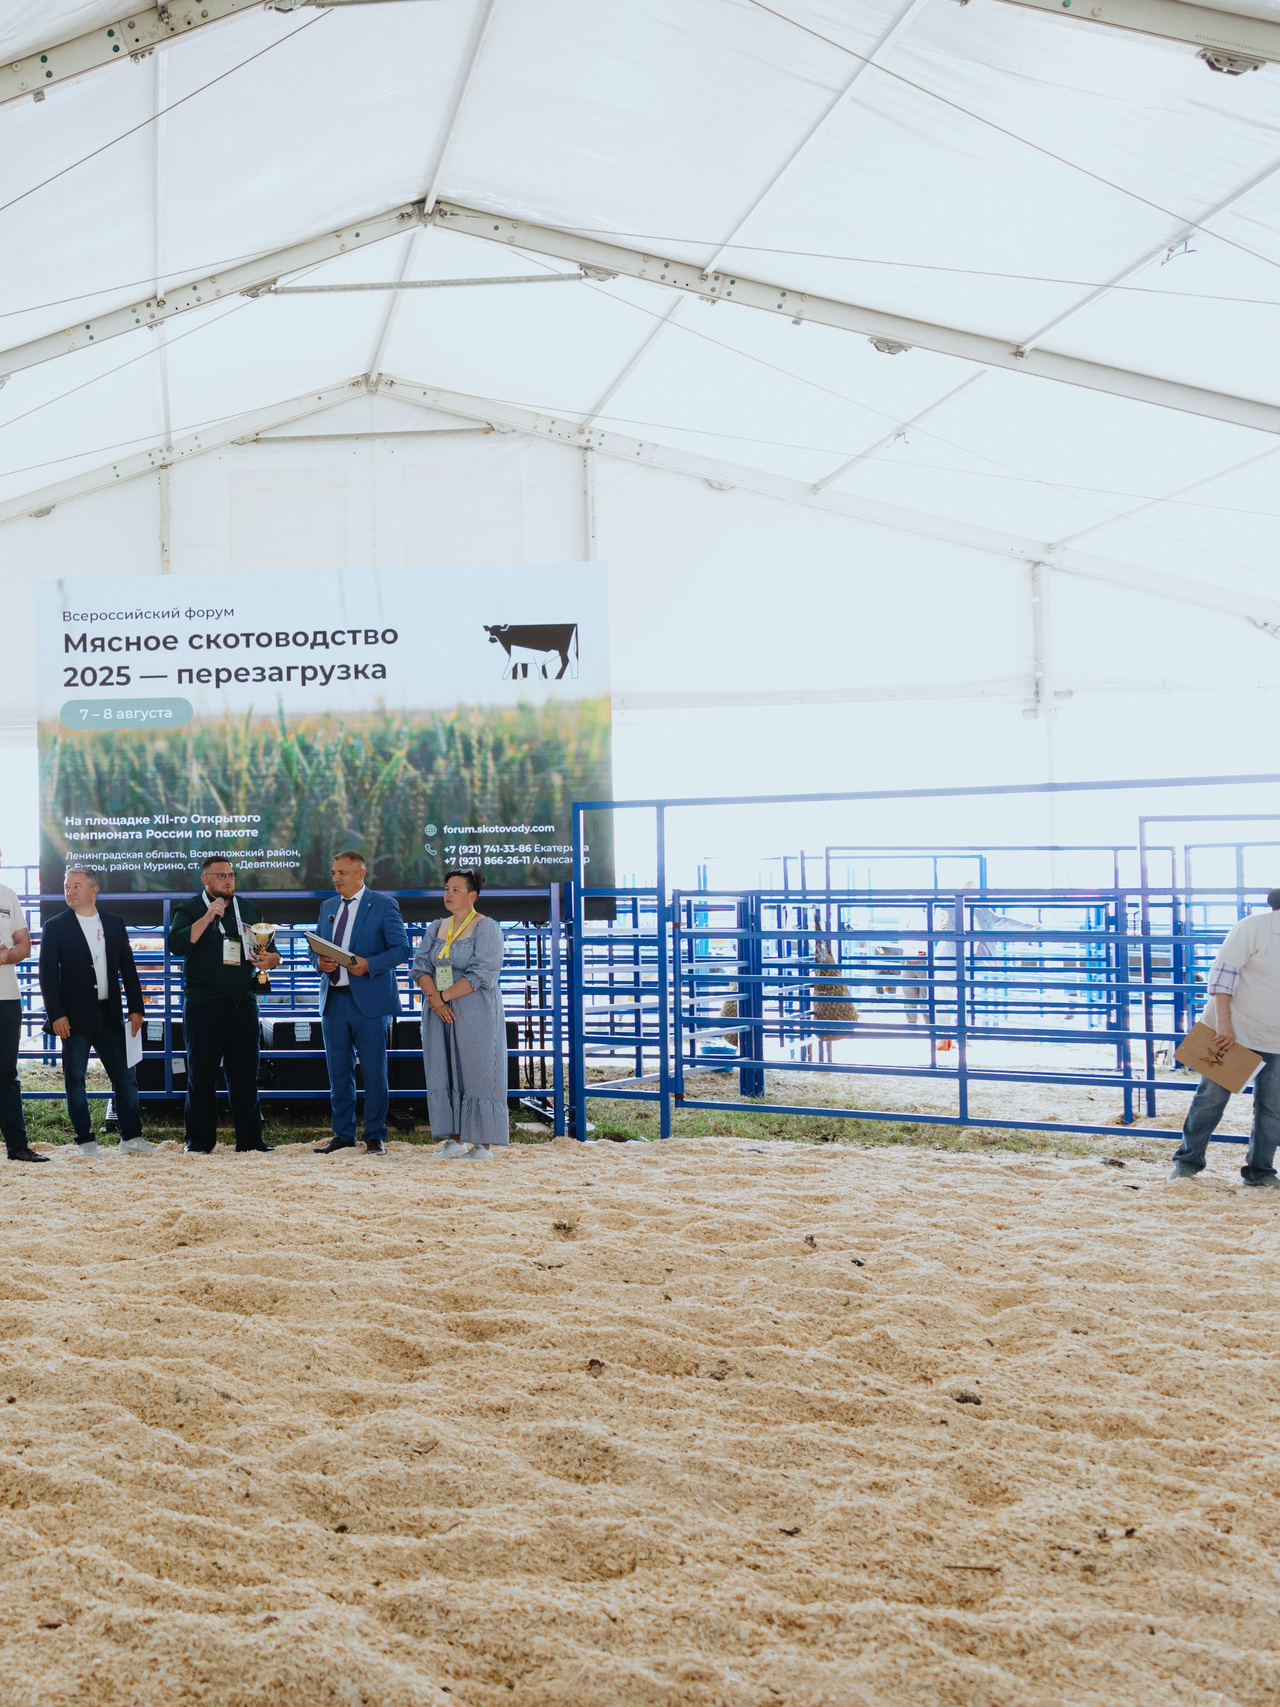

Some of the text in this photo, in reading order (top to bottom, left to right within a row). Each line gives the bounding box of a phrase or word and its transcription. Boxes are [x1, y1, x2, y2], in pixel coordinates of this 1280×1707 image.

[62, 606, 234, 624] Всероссийский форум
[64, 628, 399, 654] Мясное скотоводство
[63, 665, 131, 688] 2025
[177, 663, 387, 689] перезагрузка
[79, 708, 89, 720] 7
[103, 708, 113, 720] 8
[116, 709, 173, 722] августа
[65, 813, 261, 826] На площадке XII-го Открытого
[64, 829, 259, 840] чемпионата России по пахоте
[443, 823, 555, 835] forum.skotovody.com
[64, 848, 301, 861] Ленинградская область, Всеволожский район,
[444, 843, 589, 856] +7 (921) 741-33-86 Екатериа
[109, 862, 141, 873] район
[143, 861, 186, 872] Мурино,
[187, 862, 200, 870] ст.
[235, 860, 300, 870] «Девяткино»
[444, 855, 591, 867] +7 (921) 866-26-11 Алексанр
